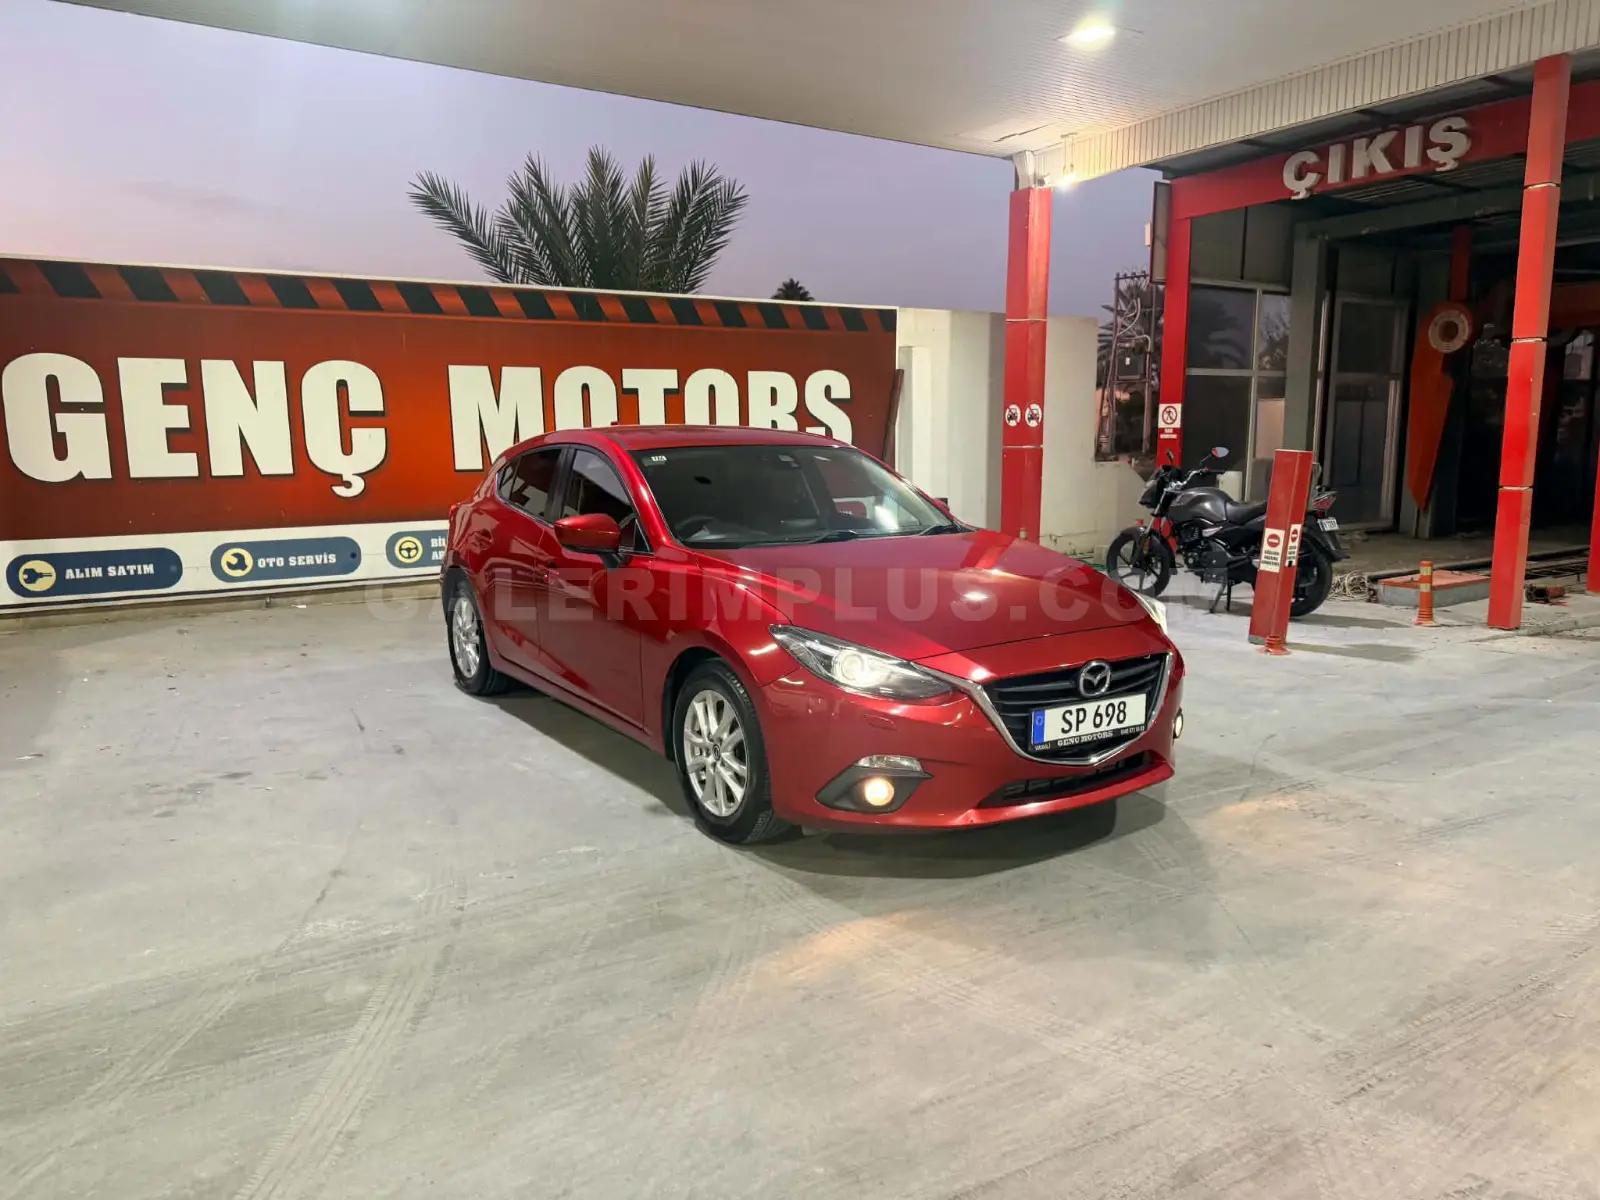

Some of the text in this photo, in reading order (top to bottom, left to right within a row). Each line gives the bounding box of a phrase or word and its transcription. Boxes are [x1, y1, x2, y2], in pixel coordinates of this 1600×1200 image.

[1282, 116, 1471, 200] ÇIKIŞ
[1, 352, 853, 498] GENÇ MOTORS
[65, 563, 155, 580] ALIM SATIM
[257, 553, 337, 569] OTO SERVİS
[1061, 700, 1127, 734] SP 698
